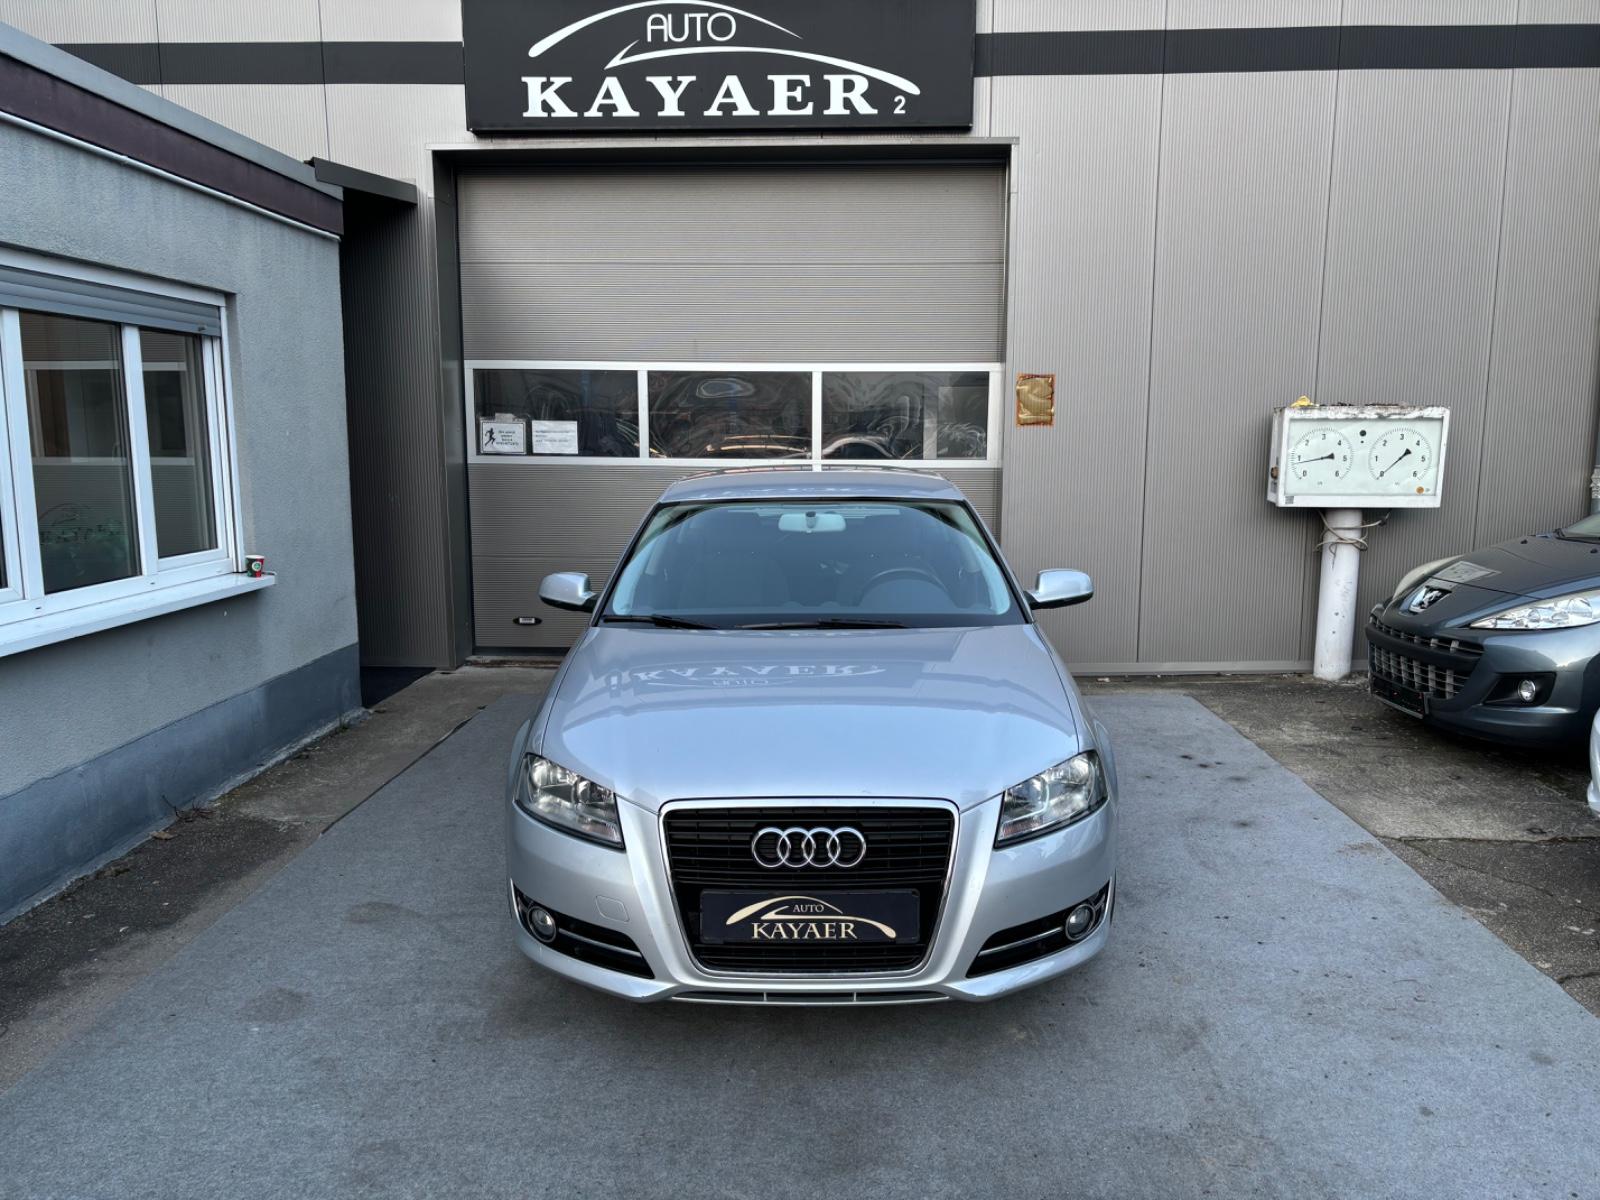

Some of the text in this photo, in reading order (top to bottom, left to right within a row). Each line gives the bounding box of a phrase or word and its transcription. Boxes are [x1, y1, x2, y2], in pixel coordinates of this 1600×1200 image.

[647, 13, 736, 42] AUTO
[521, 74, 906, 118] KAYAER 2
[792, 904, 824, 913] AUTO
[751, 922, 858, 940] KAYAER
